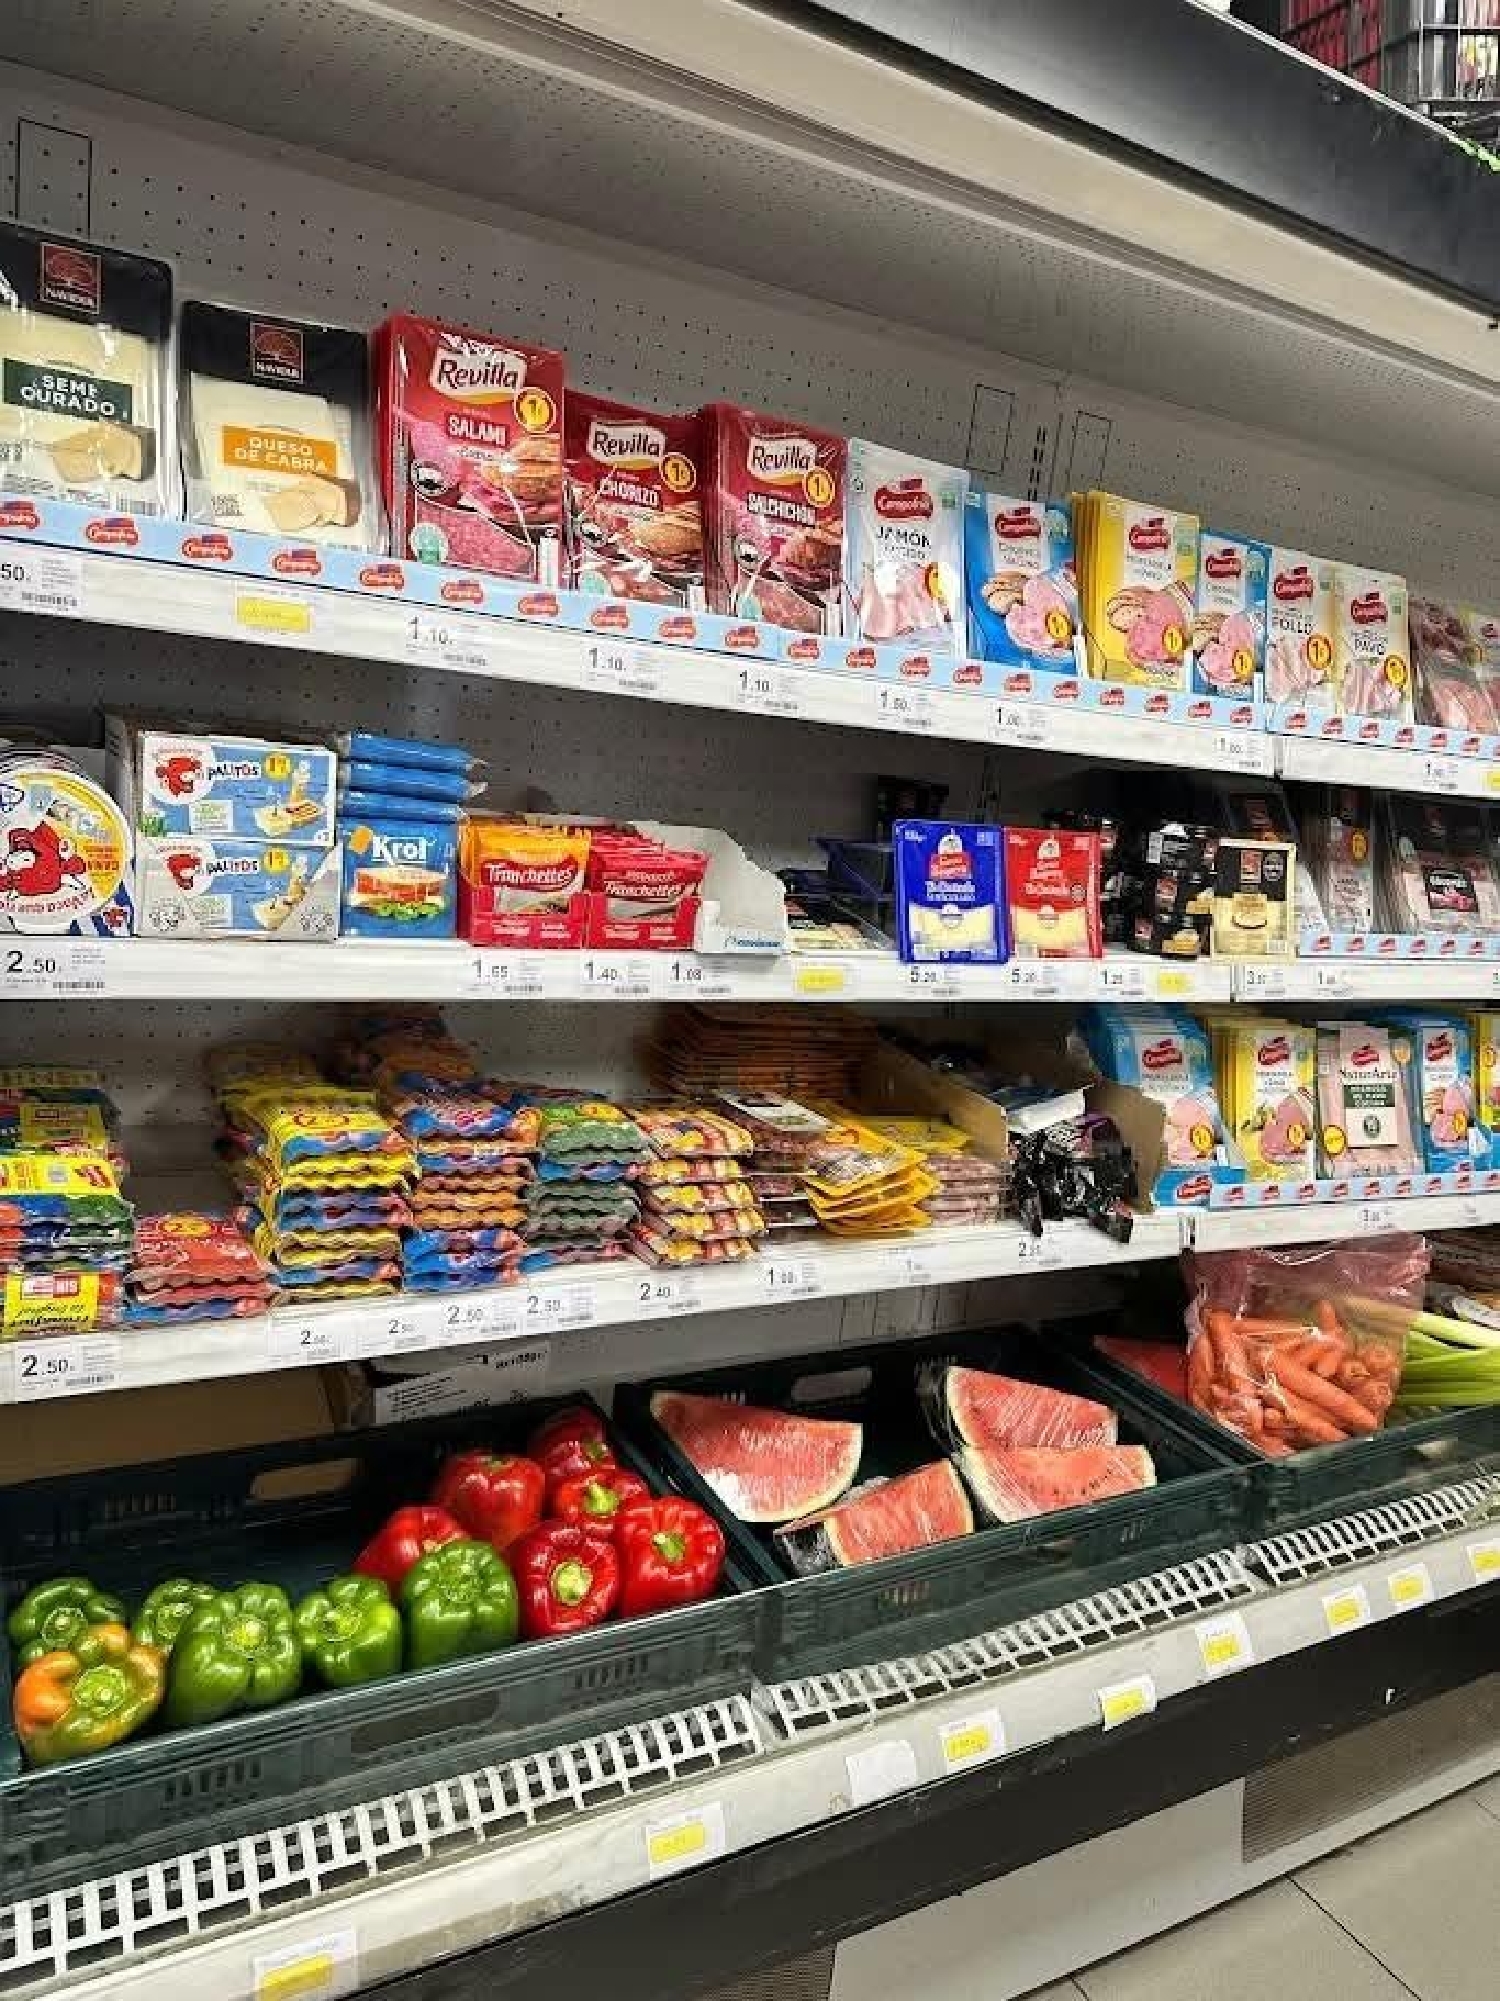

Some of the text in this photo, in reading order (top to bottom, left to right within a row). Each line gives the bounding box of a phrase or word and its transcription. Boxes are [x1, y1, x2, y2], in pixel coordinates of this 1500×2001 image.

[437, 359, 519, 389] Revilla
[448, 415, 506, 446] SALAMI
[250, 436, 313, 456] QUESO
[594, 431, 660, 457] Revilla
[234, 447, 328, 471] DE CABRA
[752, 446, 809, 470] Revilla
[6, 950, 56, 973] 2.50
[22, 1354, 70, 1377] 2.50
